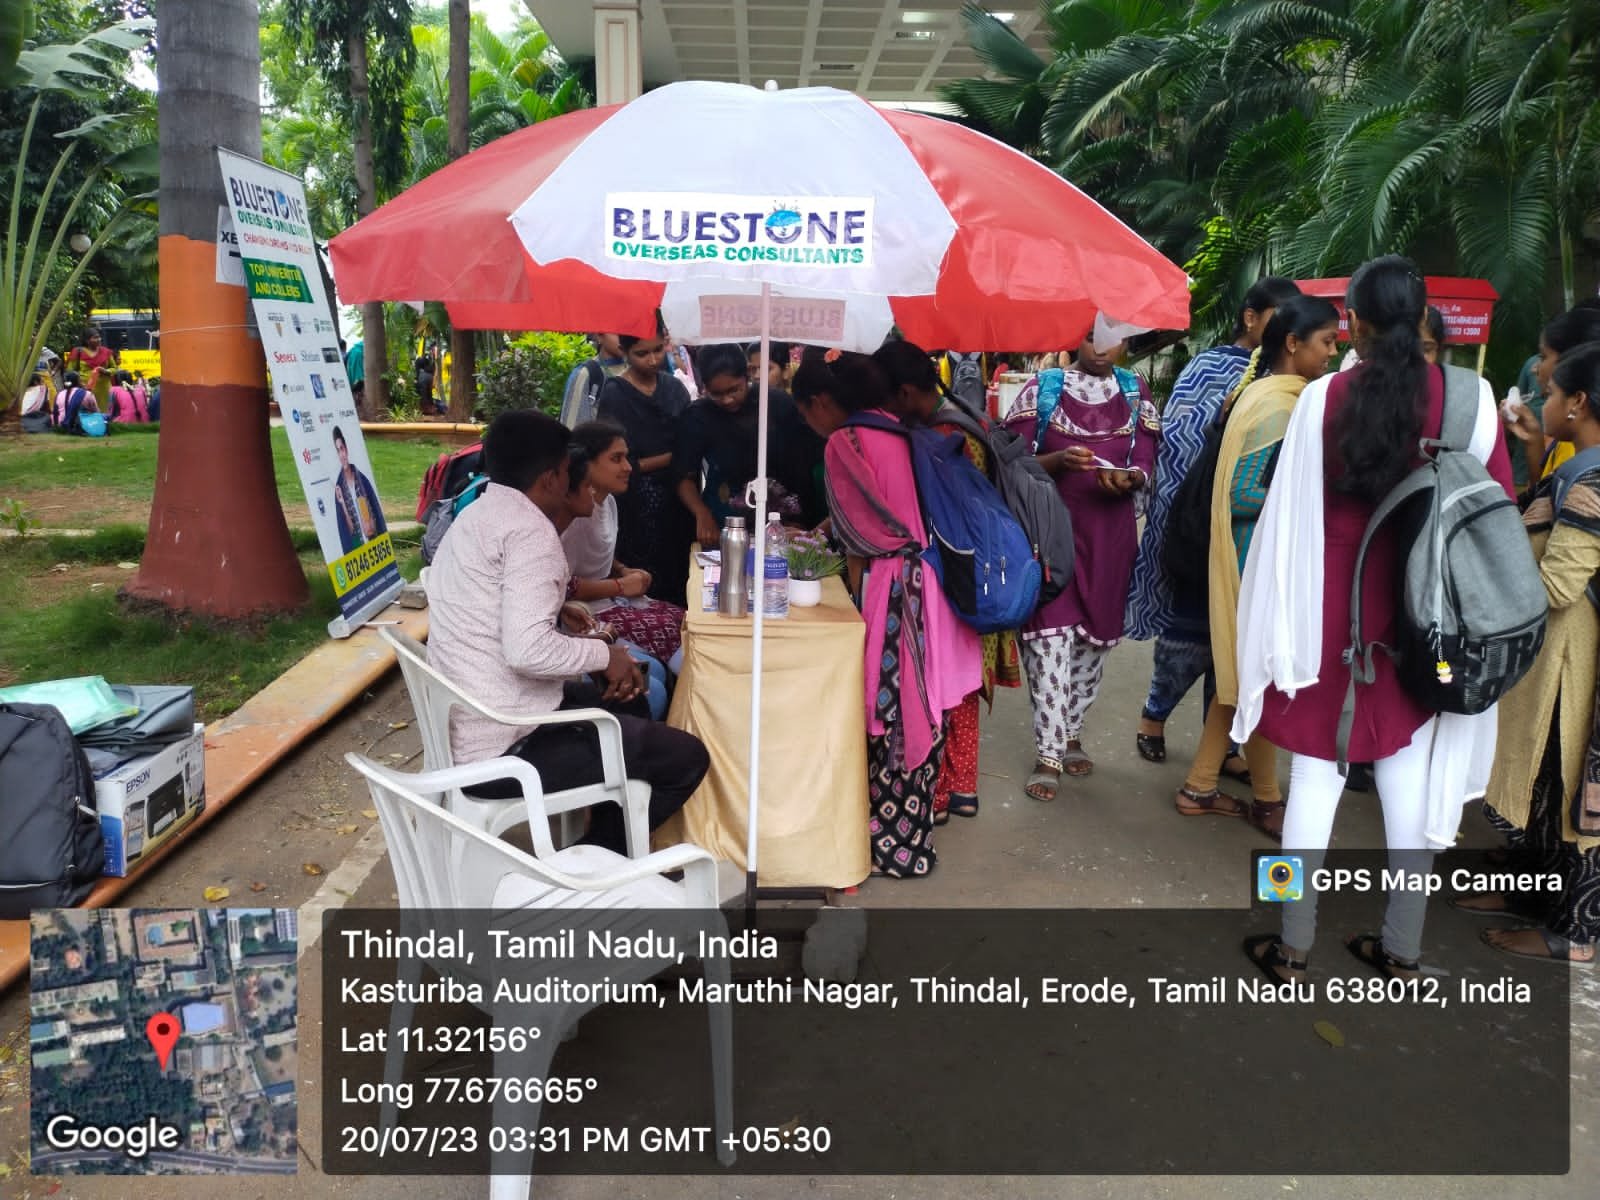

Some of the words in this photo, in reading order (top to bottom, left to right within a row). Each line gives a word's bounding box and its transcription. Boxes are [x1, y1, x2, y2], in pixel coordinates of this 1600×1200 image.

[229, 176, 306, 225] BLUESTONE
[220, 229, 239, 245] XE
[612, 207, 867, 246] BLUESTONE
[612, 241, 719, 261] OVERSEAS
[723, 245, 865, 265] CONSULTANTS
[126, 768, 151, 793] EPSON
